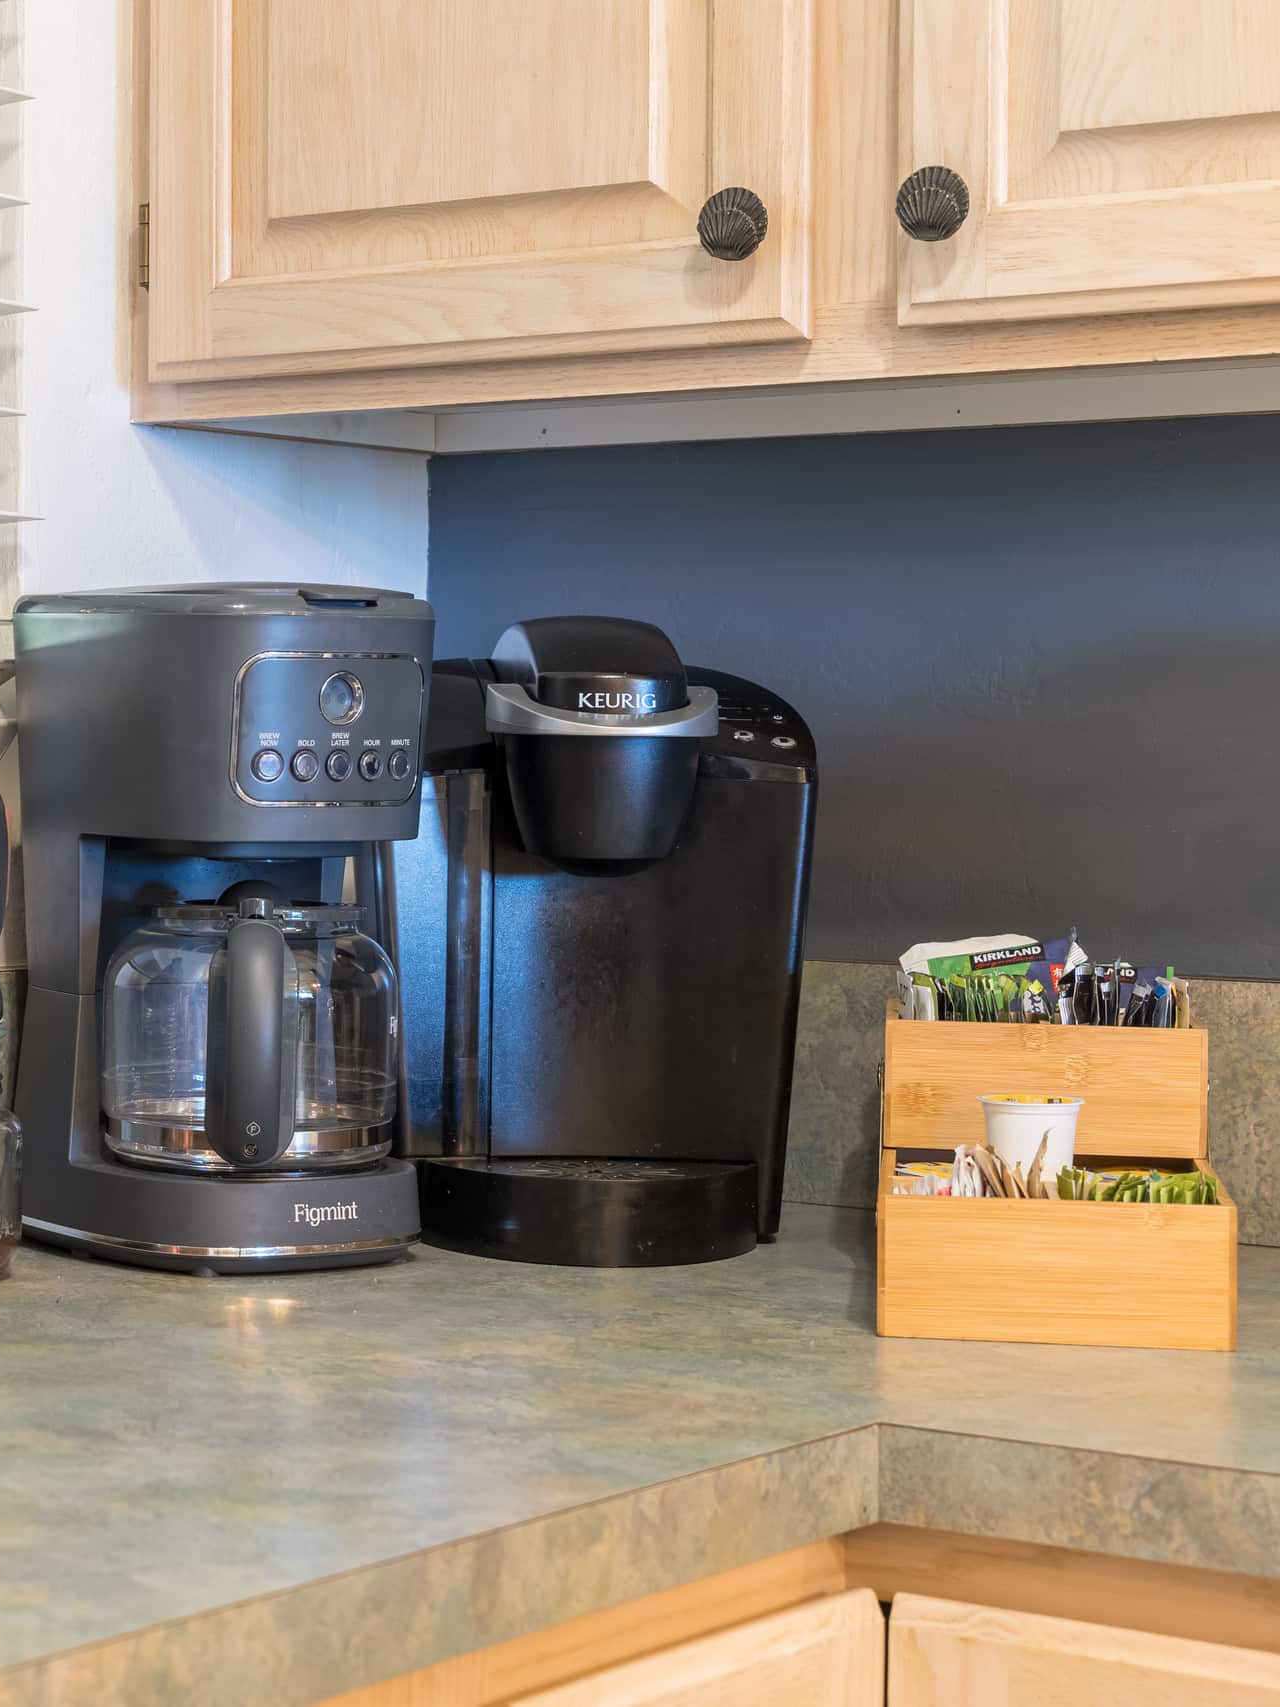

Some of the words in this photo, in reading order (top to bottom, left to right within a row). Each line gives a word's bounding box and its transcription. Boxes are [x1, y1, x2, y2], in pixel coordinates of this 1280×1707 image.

[578, 692, 657, 709] KEURIG
[390, 739, 411, 747] MINUTE
[973, 945, 1042, 964] KIRKLAND
[294, 1201, 359, 1227] Figmint
